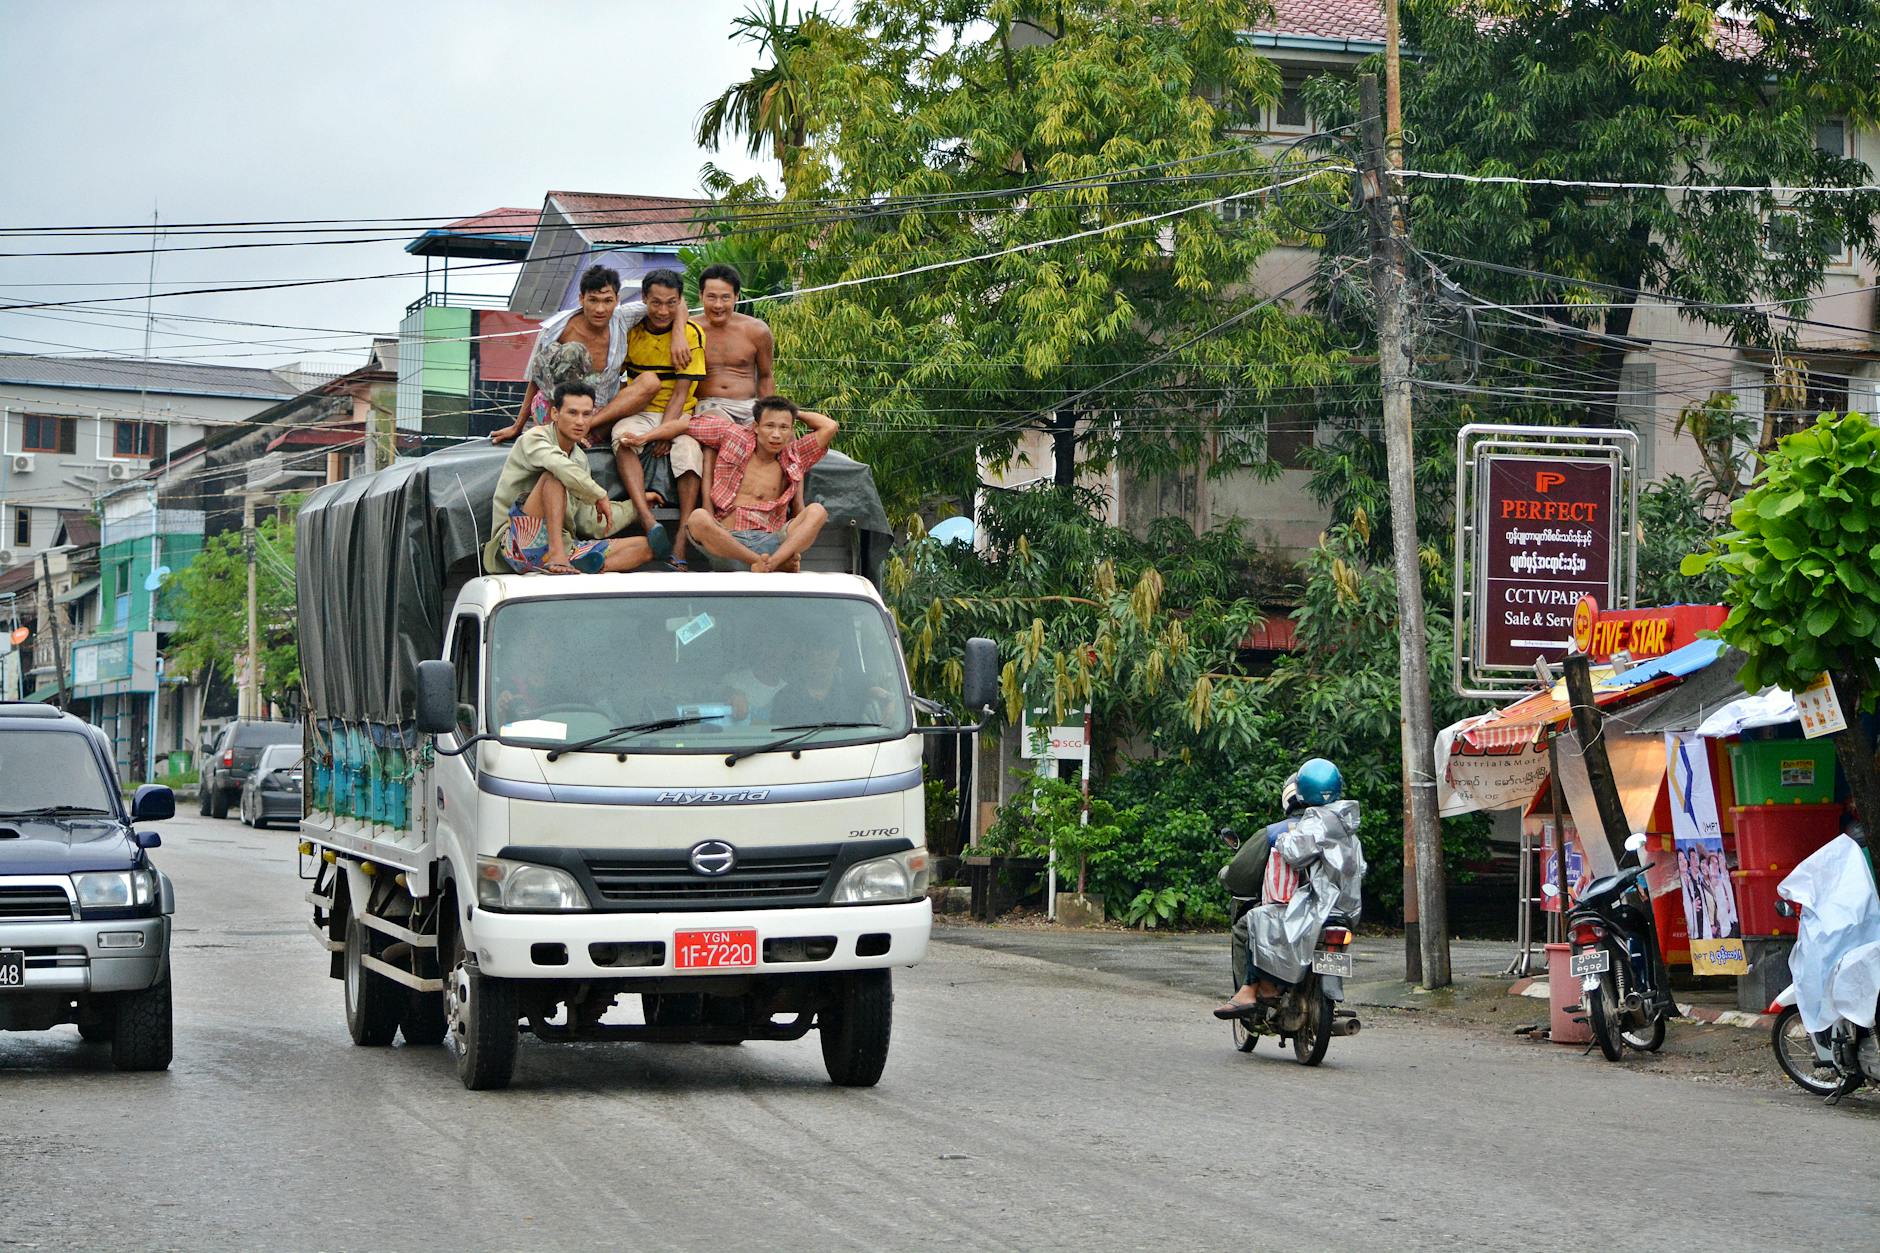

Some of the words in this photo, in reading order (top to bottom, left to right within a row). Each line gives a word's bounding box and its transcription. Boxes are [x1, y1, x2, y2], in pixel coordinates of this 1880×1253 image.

[1501, 499, 1598, 522] PERFECT
[1504, 611, 1529, 625] Sale
[1532, 612, 1543, 626] &
[1591, 621, 1624, 655] FIVE
[1629, 619, 1667, 654] STAR
[1062, 740, 1081, 748] SCG
[656, 790, 771, 805] Hybrid
[848, 828, 900, 838] DUTRO
[702, 932, 730, 943] YGN
[681, 943, 752, 967] 1F-7220
[0, 964, 19, 984] 48
